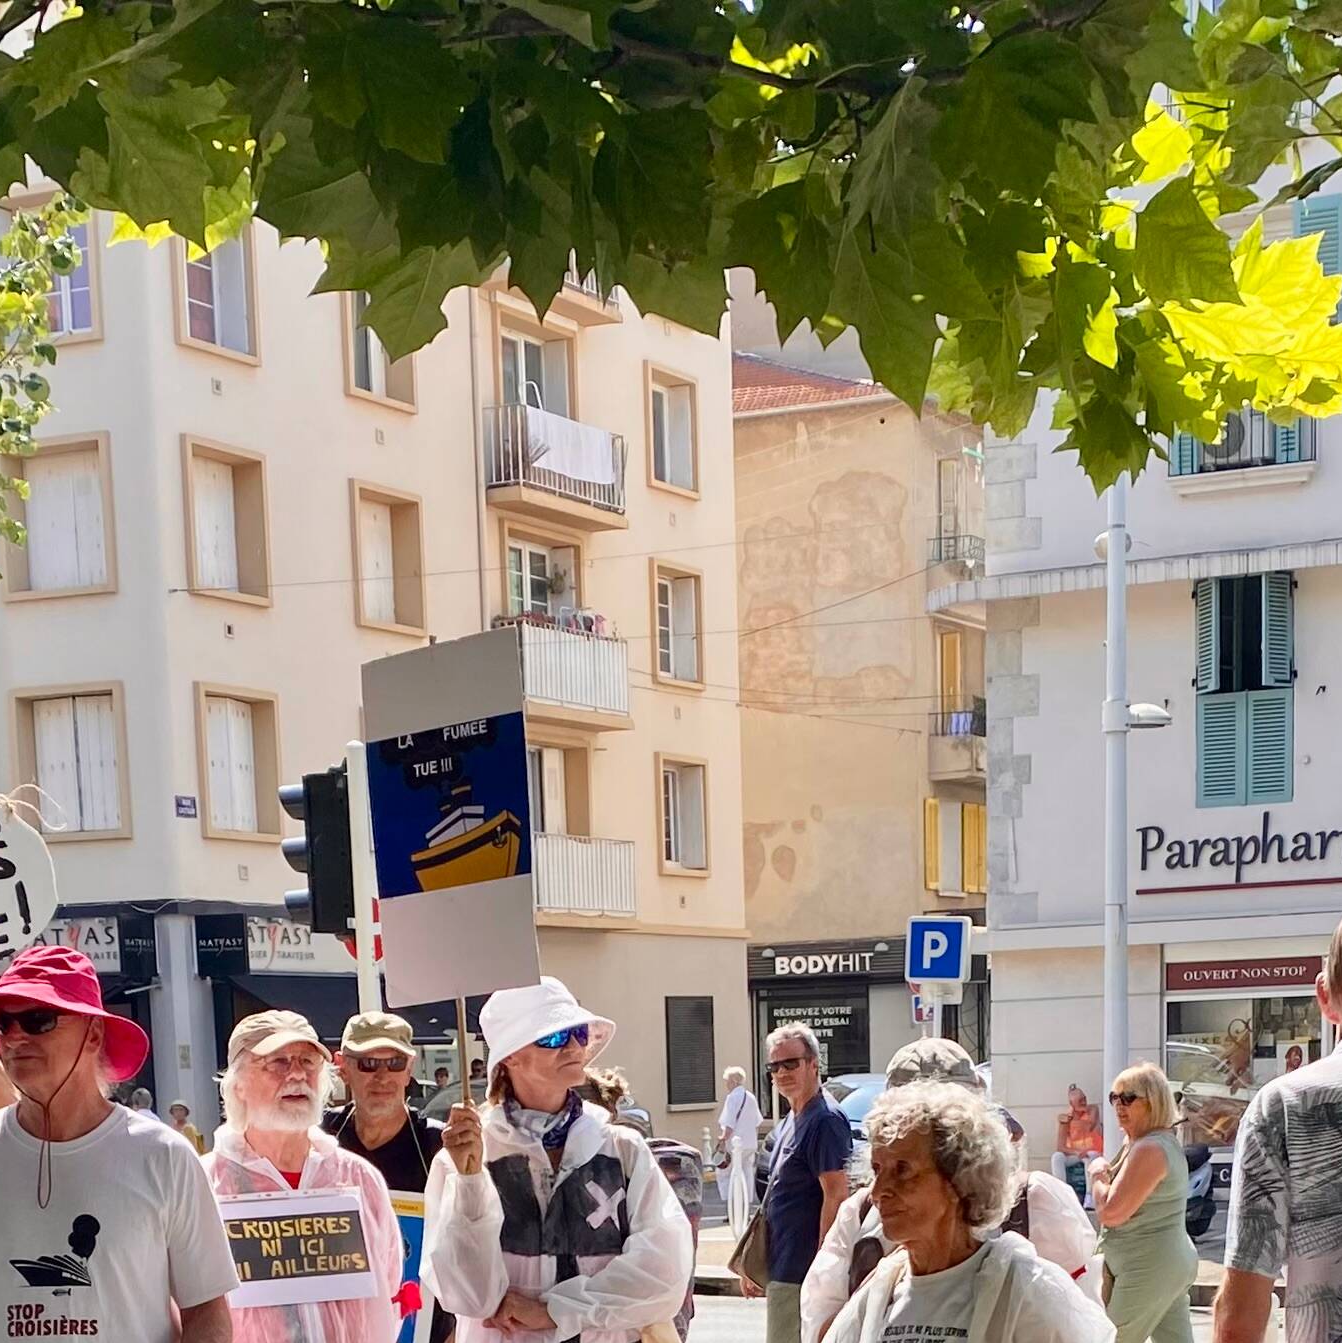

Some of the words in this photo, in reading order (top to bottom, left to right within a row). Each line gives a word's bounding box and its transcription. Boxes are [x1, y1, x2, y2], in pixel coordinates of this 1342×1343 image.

[397, 734, 414, 749] LA
[413, 760, 438, 778] TUE
[922, 931, 949, 969] P
[774, 952, 874, 975] BODYHIT
[1183, 968, 1238, 981] OUVERT
[1240, 967, 1271, 979] NON
[1273, 966, 1307, 977] STOP
[821, 1006, 853, 1015] VOTRE
[814, 1018, 850, 1027] D'ESSAI
[227, 1217, 351, 1239] CROISIERES
[261, 1239, 283, 1257] NI
[300, 1238, 324, 1255] ICI
[270, 1253, 366, 1278] AILLEURS
[7, 1304, 45, 1321] STOP
[7, 1315, 99, 1337] CROISIÈRES
